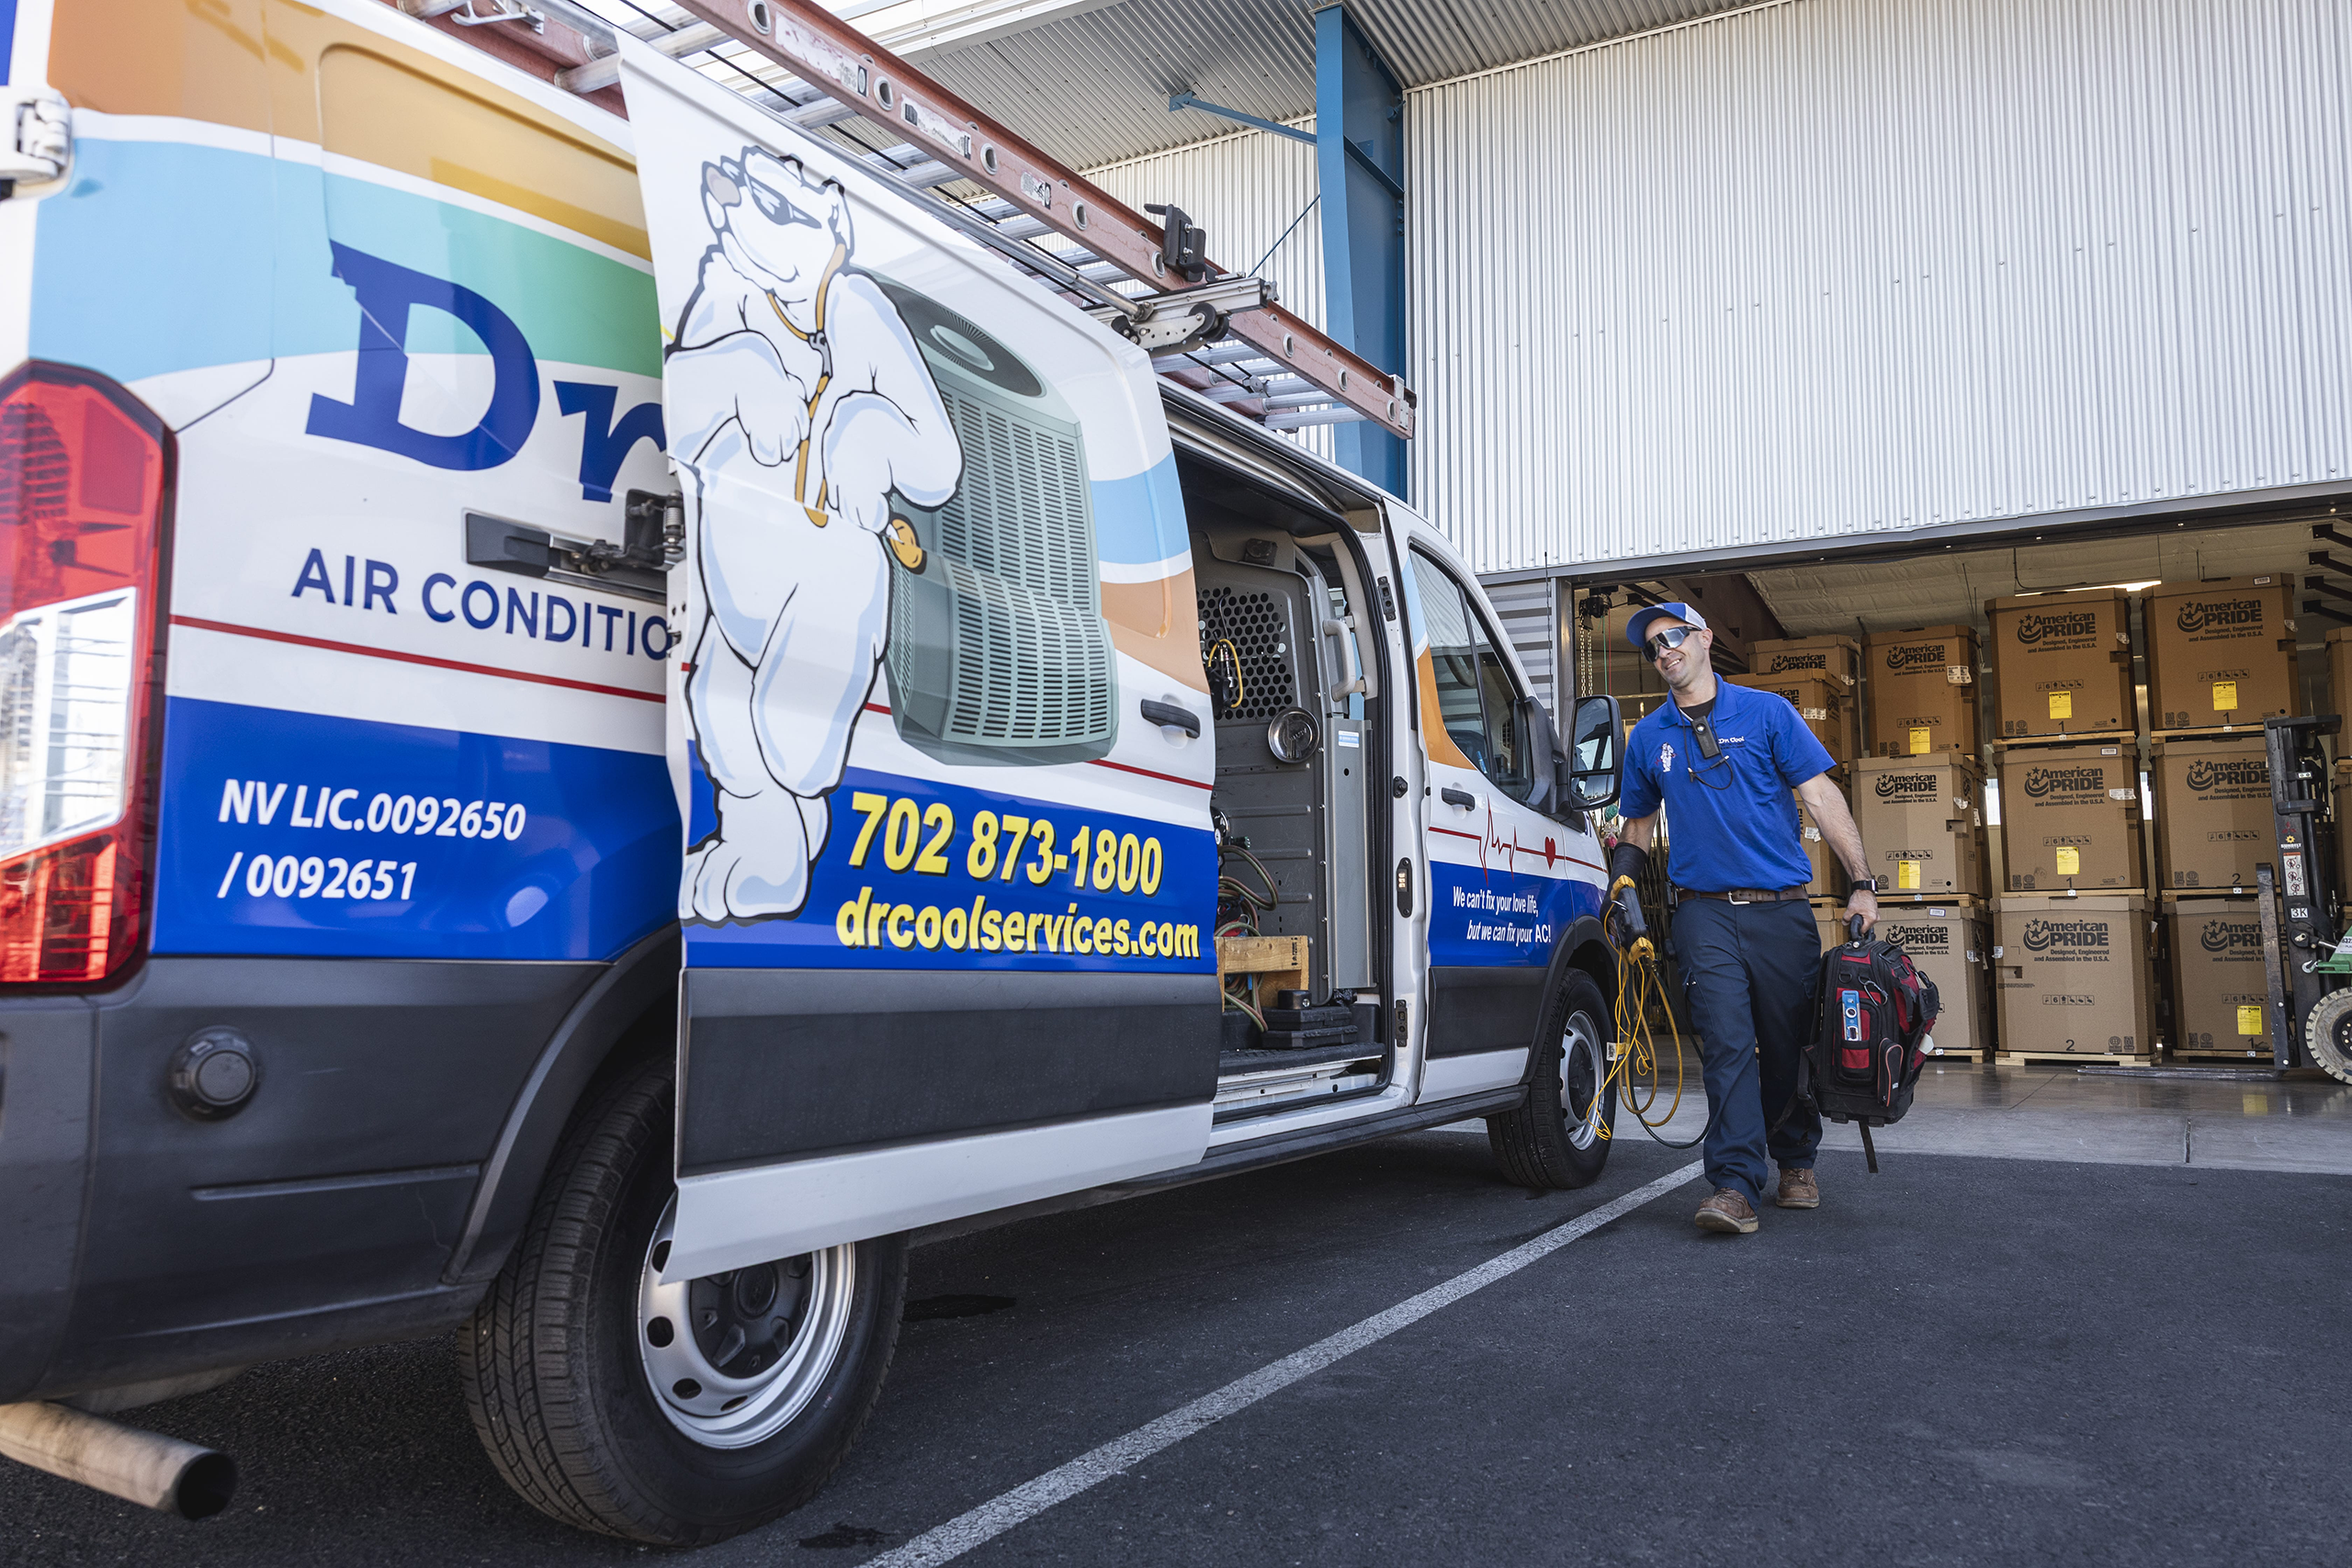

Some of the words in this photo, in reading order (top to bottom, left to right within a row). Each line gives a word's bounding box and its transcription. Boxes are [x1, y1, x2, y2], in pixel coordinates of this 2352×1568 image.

[305, 240, 667, 503] Dr
[291, 547, 399, 615] AIR
[422, 571, 673, 661] CONDITIO
[2195, 599, 2261, 613] American
[2033, 612, 2096, 625] American
[2204, 609, 2262, 626] PRIDE
[2042, 622, 2096, 637] PRIDE
[1899, 644, 1944, 655] American
[1782, 653, 1826, 663] American
[1905, 652, 1945, 664] PRIDE
[1789, 661, 1826, 670] PRIDE
[2223, 712, 2229, 724] 1
[2059, 721, 2064, 731] 1
[1888, 773, 1936, 784] American
[2041, 766, 2103, 779] American
[2213, 770, 2270, 785] PRIDE
[1894, 782, 1937, 793] PRIDE
[2050, 777, 2104, 792] PRIDE
[219, 779, 288, 825] NV
[290, 784, 526, 841] LIC.0092650
[848, 791, 956, 875] 702
[967, 810, 1163, 896] 873-1800
[245, 854, 417, 900] 0092651
[2066, 876, 2072, 887] 1
[2232, 874, 2241, 885] 2
[1453, 886, 1464, 907] We
[1466, 888, 1485, 908] can't
[1486, 890, 1495, 908] fix
[1496, 894, 1511, 915] your
[1512, 893, 1525, 913] love
[1527, 895, 1538, 917] life,
[2292, 908, 2308, 918] 3K
[836, 886, 1201, 959] drcoolservices.com
[1898, 925, 1948, 933] American
[2041, 919, 2108, 932] American
[2219, 921, 2286, 933] Amerin
[1466, 920, 1481, 940] but
[1481, 926, 1492, 939] we
[1493, 928, 1506, 942] can
[1507, 924, 1515, 942] fix
[1516, 926, 1532, 946] your
[1535, 924, 1551, 942] AC!
[1905, 934, 1948, 943] PRIDE
[2051, 932, 2109, 946] PRIDE
[2229, 933, 2288, 946] PRIE
[2065, 1040, 2075, 1051] 2
[2248, 1037, 2254, 1049] 1
